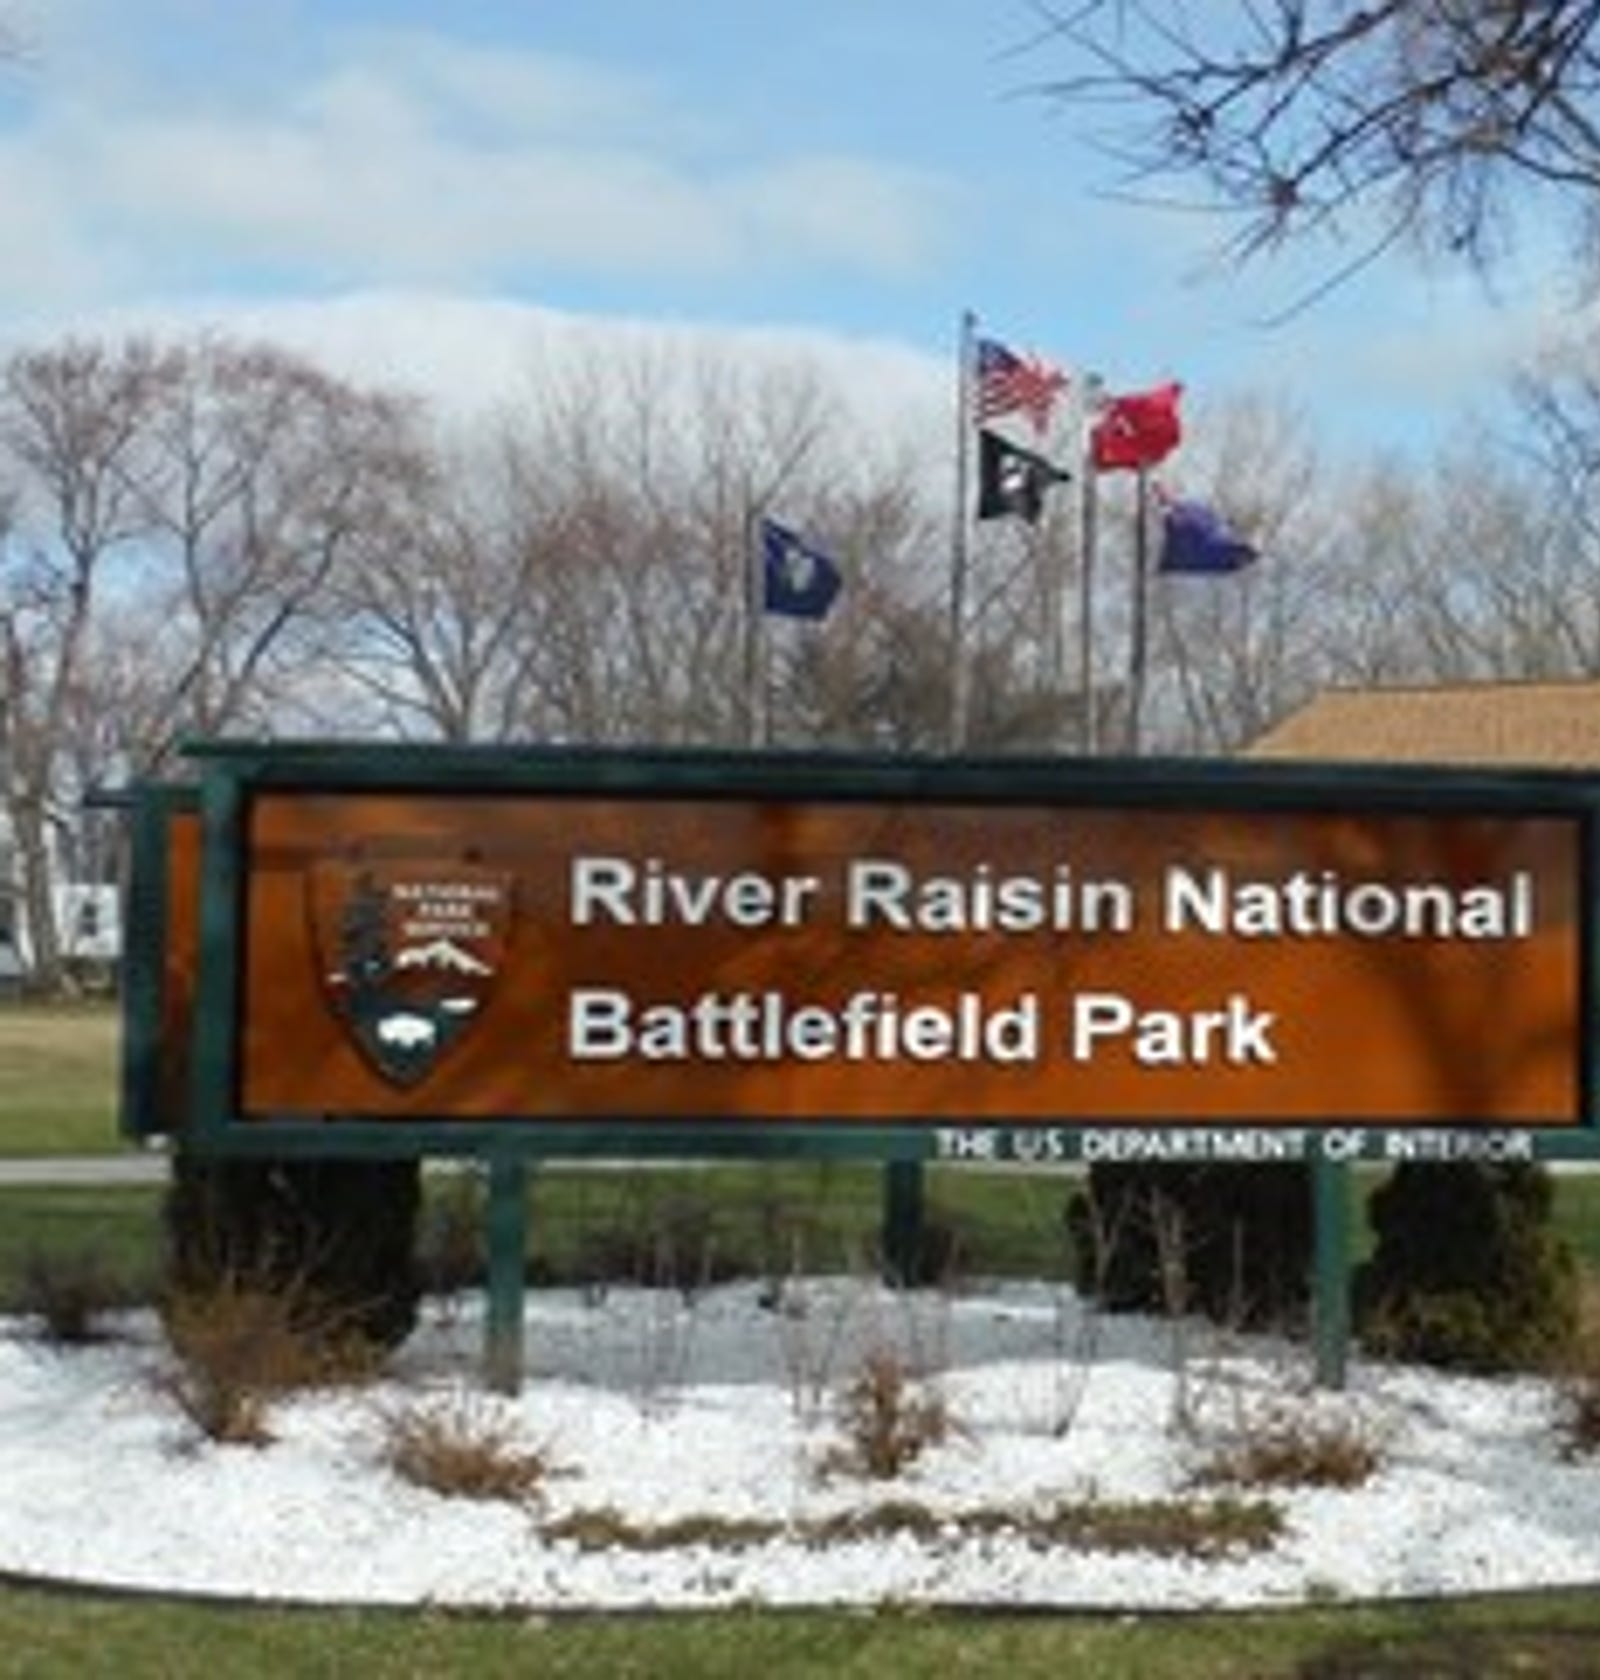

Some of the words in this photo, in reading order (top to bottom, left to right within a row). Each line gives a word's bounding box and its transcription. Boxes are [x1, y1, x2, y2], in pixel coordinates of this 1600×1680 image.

[571, 857, 818, 927] River
[848, 861, 1132, 932] Raisin
[1165, 869, 1533, 938] National
[569, 989, 1040, 1062] Battlefield
[1073, 996, 1277, 1066] Park
[936, 1128, 996, 1158] THE
[1083, 1128, 1304, 1161] DEPARTMENT
[1322, 1129, 1368, 1160] OF
[1385, 1129, 1533, 1160] INTERIOR
